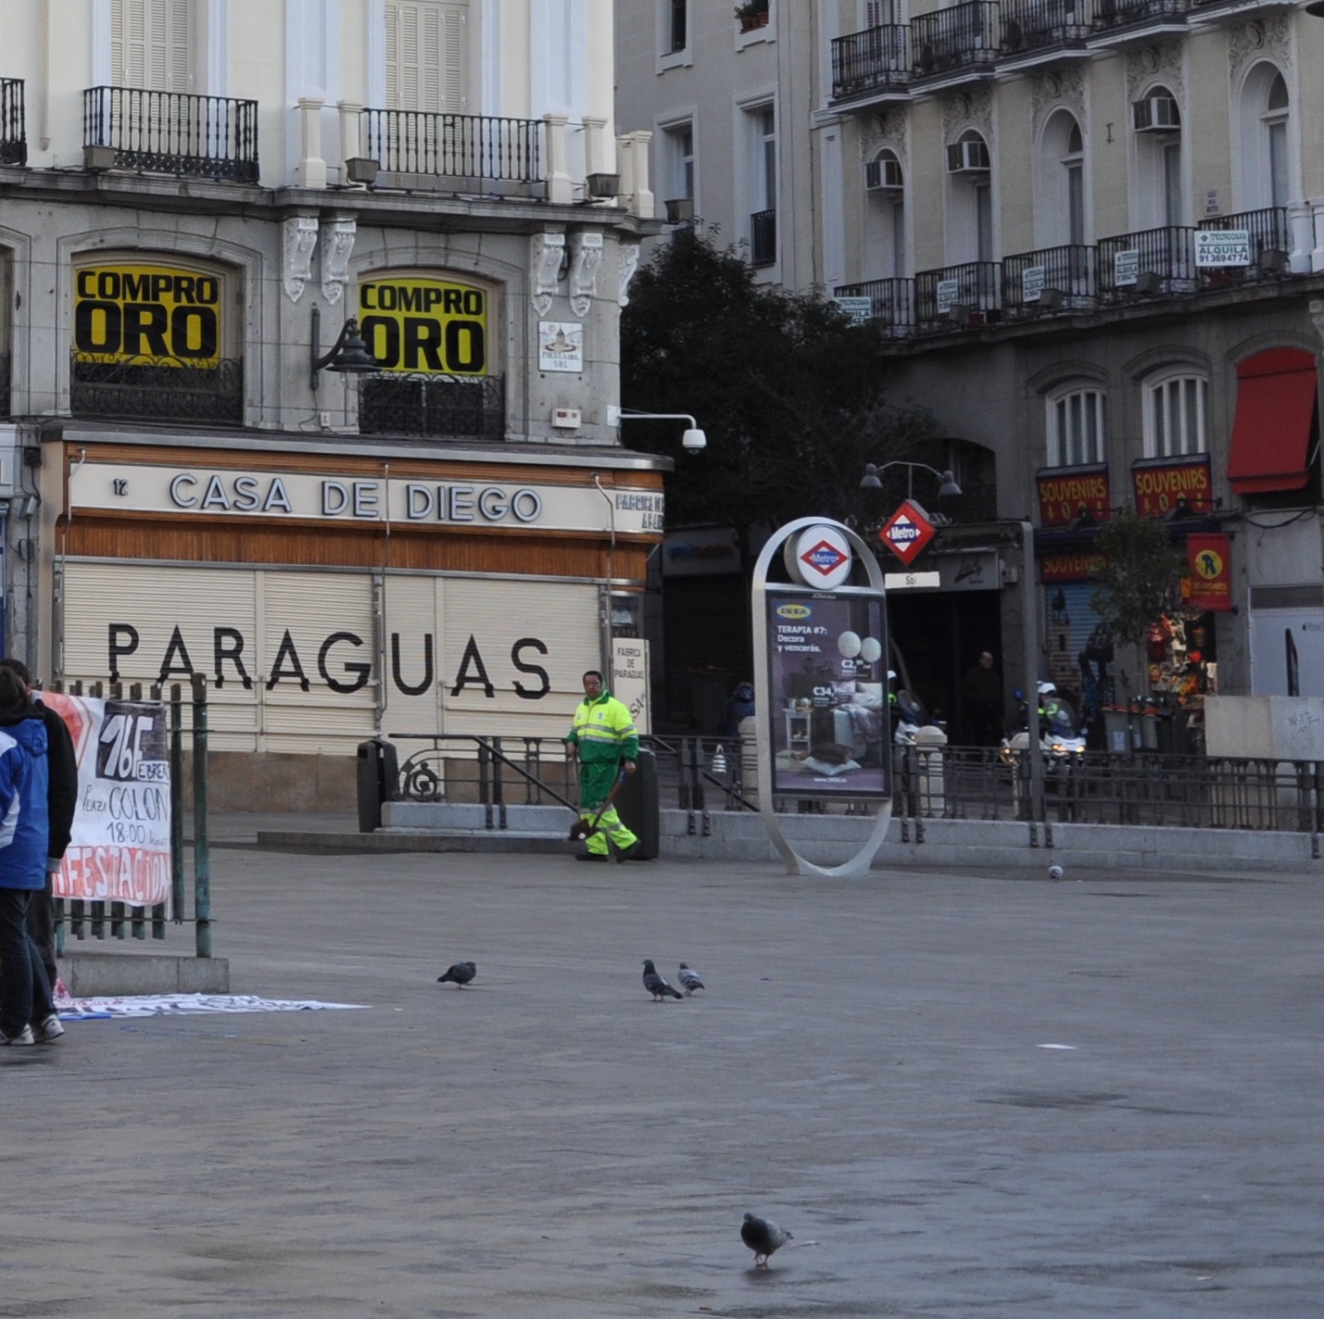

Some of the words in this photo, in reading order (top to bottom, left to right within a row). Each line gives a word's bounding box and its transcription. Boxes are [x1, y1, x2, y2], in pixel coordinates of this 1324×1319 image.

[1199, 246, 1248, 254] ALQUILA
[76, 270, 219, 305] COMPRO
[359, 283, 484, 316] COMPRO
[74, 300, 218, 360] ORO
[361, 316, 486, 373] ORO
[552, 360, 569, 369] SOL
[1040, 478, 1107, 503] SOUVENIRS
[1135, 468, 1208, 496] SOUVENIRS
[113, 477, 129, 497] 12
[168, 472, 292, 514] CASA
[321, 480, 380, 519] DE
[405, 483, 543, 523] DIEGO
[891, 526, 916, 540] Metro
[811, 553, 837, 563] Metro
[780, 607, 810, 616] IKEA
[777, 625, 812, 636] TERAPIA
[777, 634, 805, 644] Decora
[617, 647, 641, 658] FABRICA
[777, 644, 783, 653] y
[106, 622, 552, 700] PARAGUAS
[109, 786, 169, 822] COLON
[106, 821, 146, 845] 18:00
